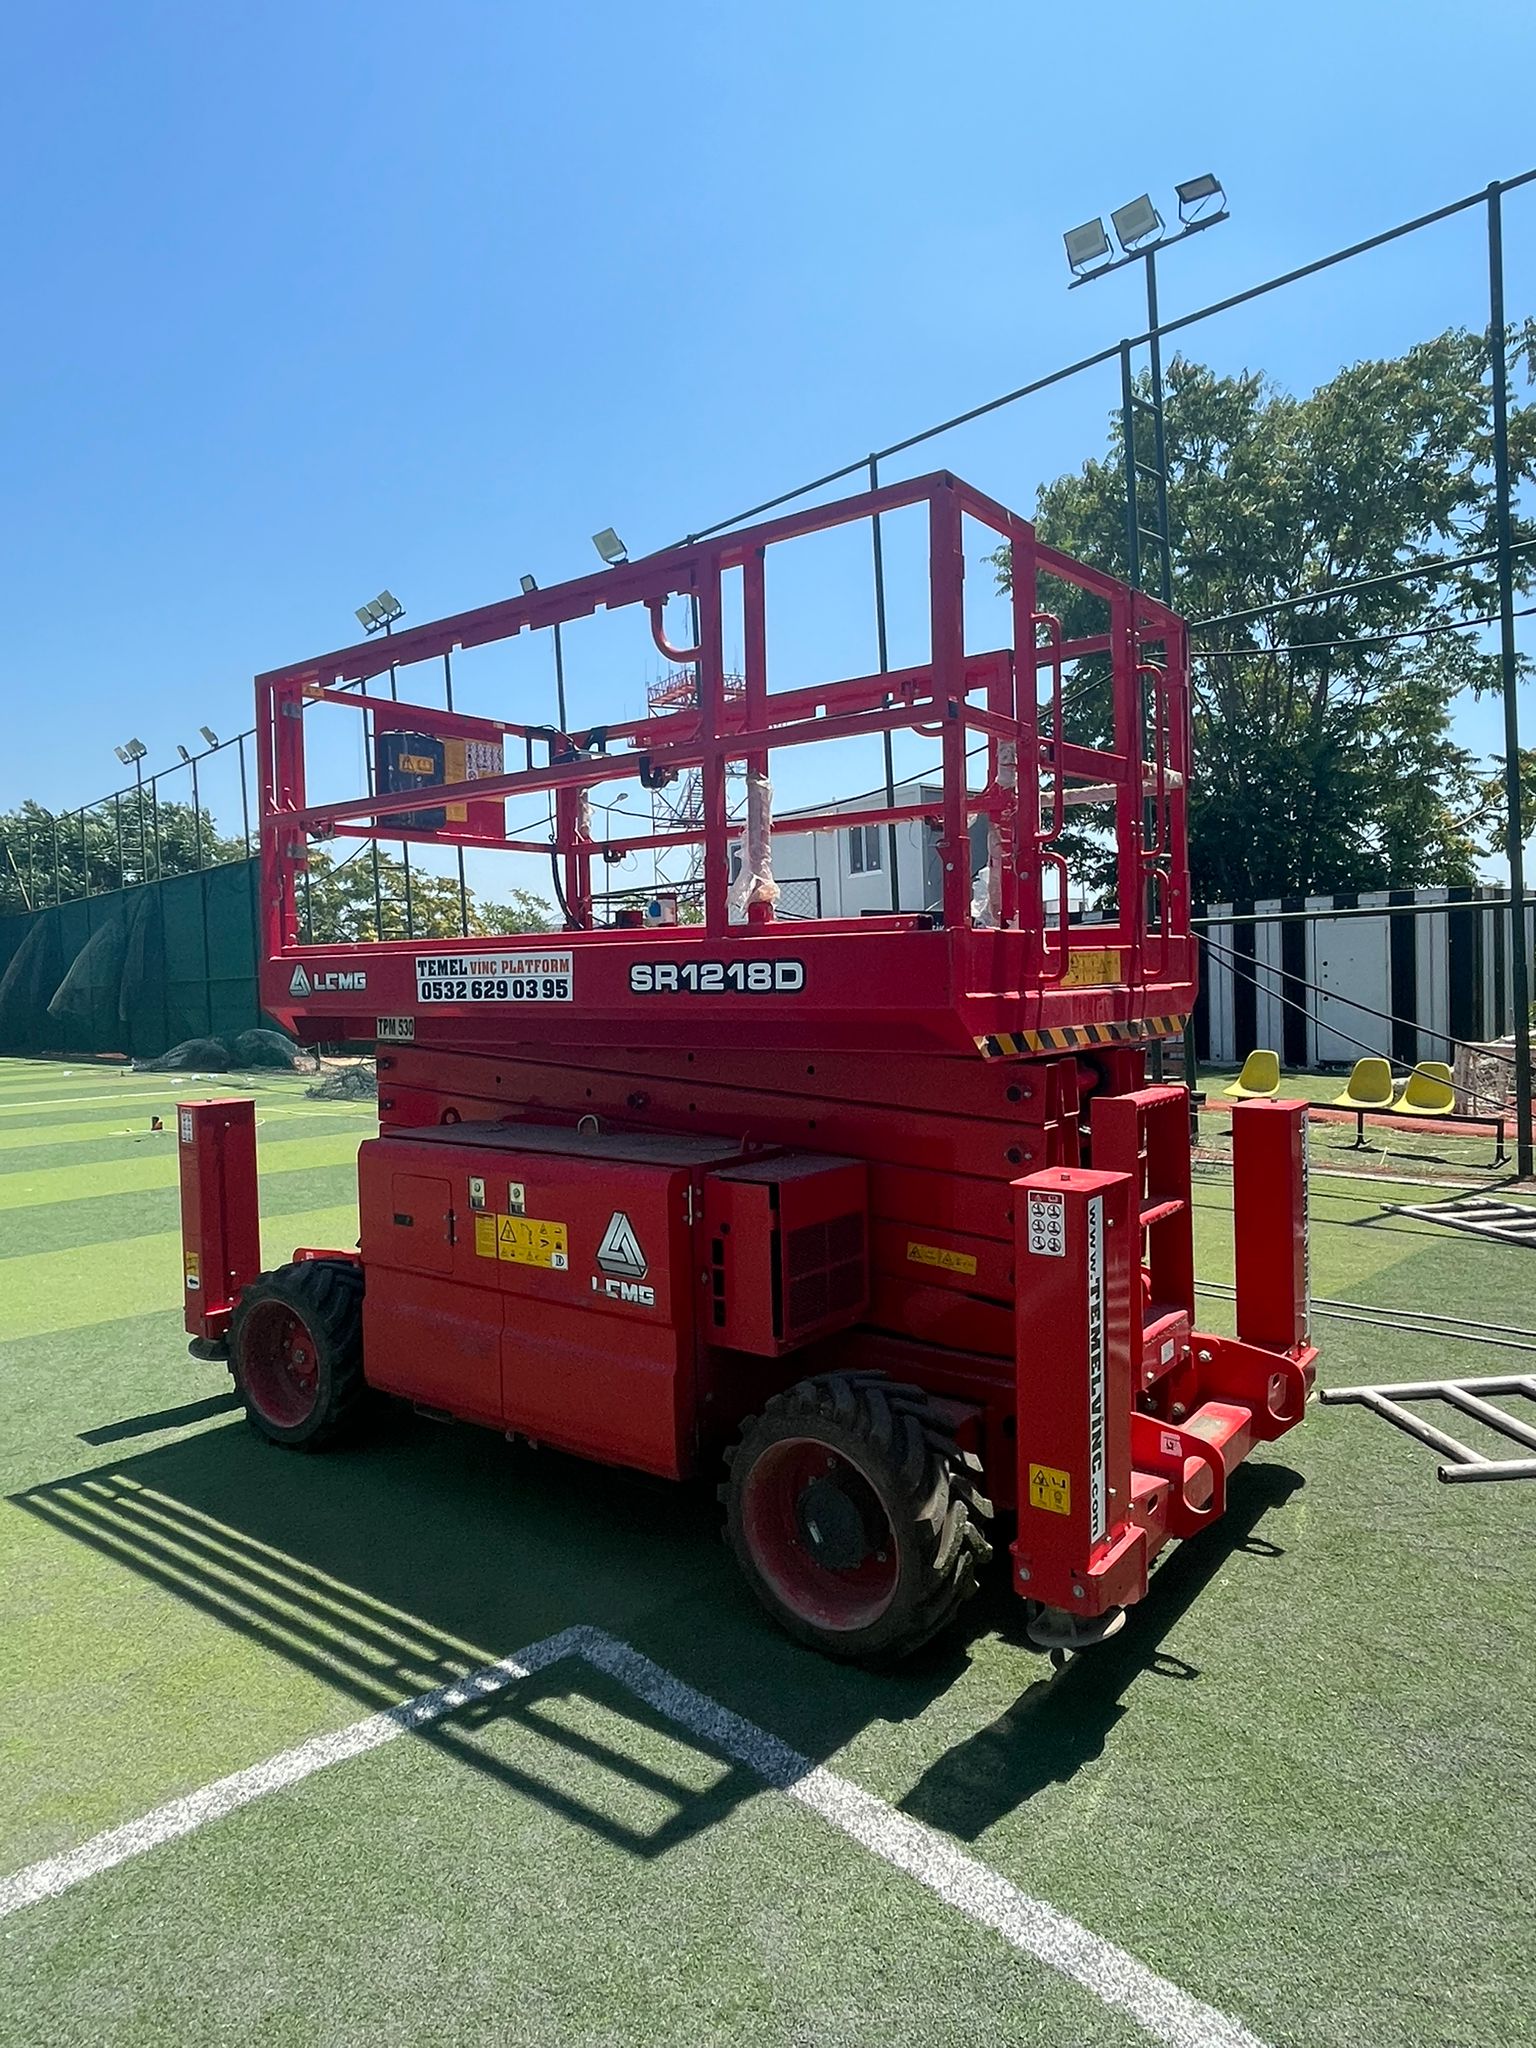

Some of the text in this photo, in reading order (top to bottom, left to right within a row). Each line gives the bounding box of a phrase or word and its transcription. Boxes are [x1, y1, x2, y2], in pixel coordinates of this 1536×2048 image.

[418, 959, 468, 976] TEMEL
[501, 959, 570, 974] PLATFORM
[631, 962, 804, 991] SR1218D
[314, 972, 366, 990] LCMG
[421, 979, 568, 1000] 0532 629 03 95
[378, 1019, 414, 1036] TPM 530
